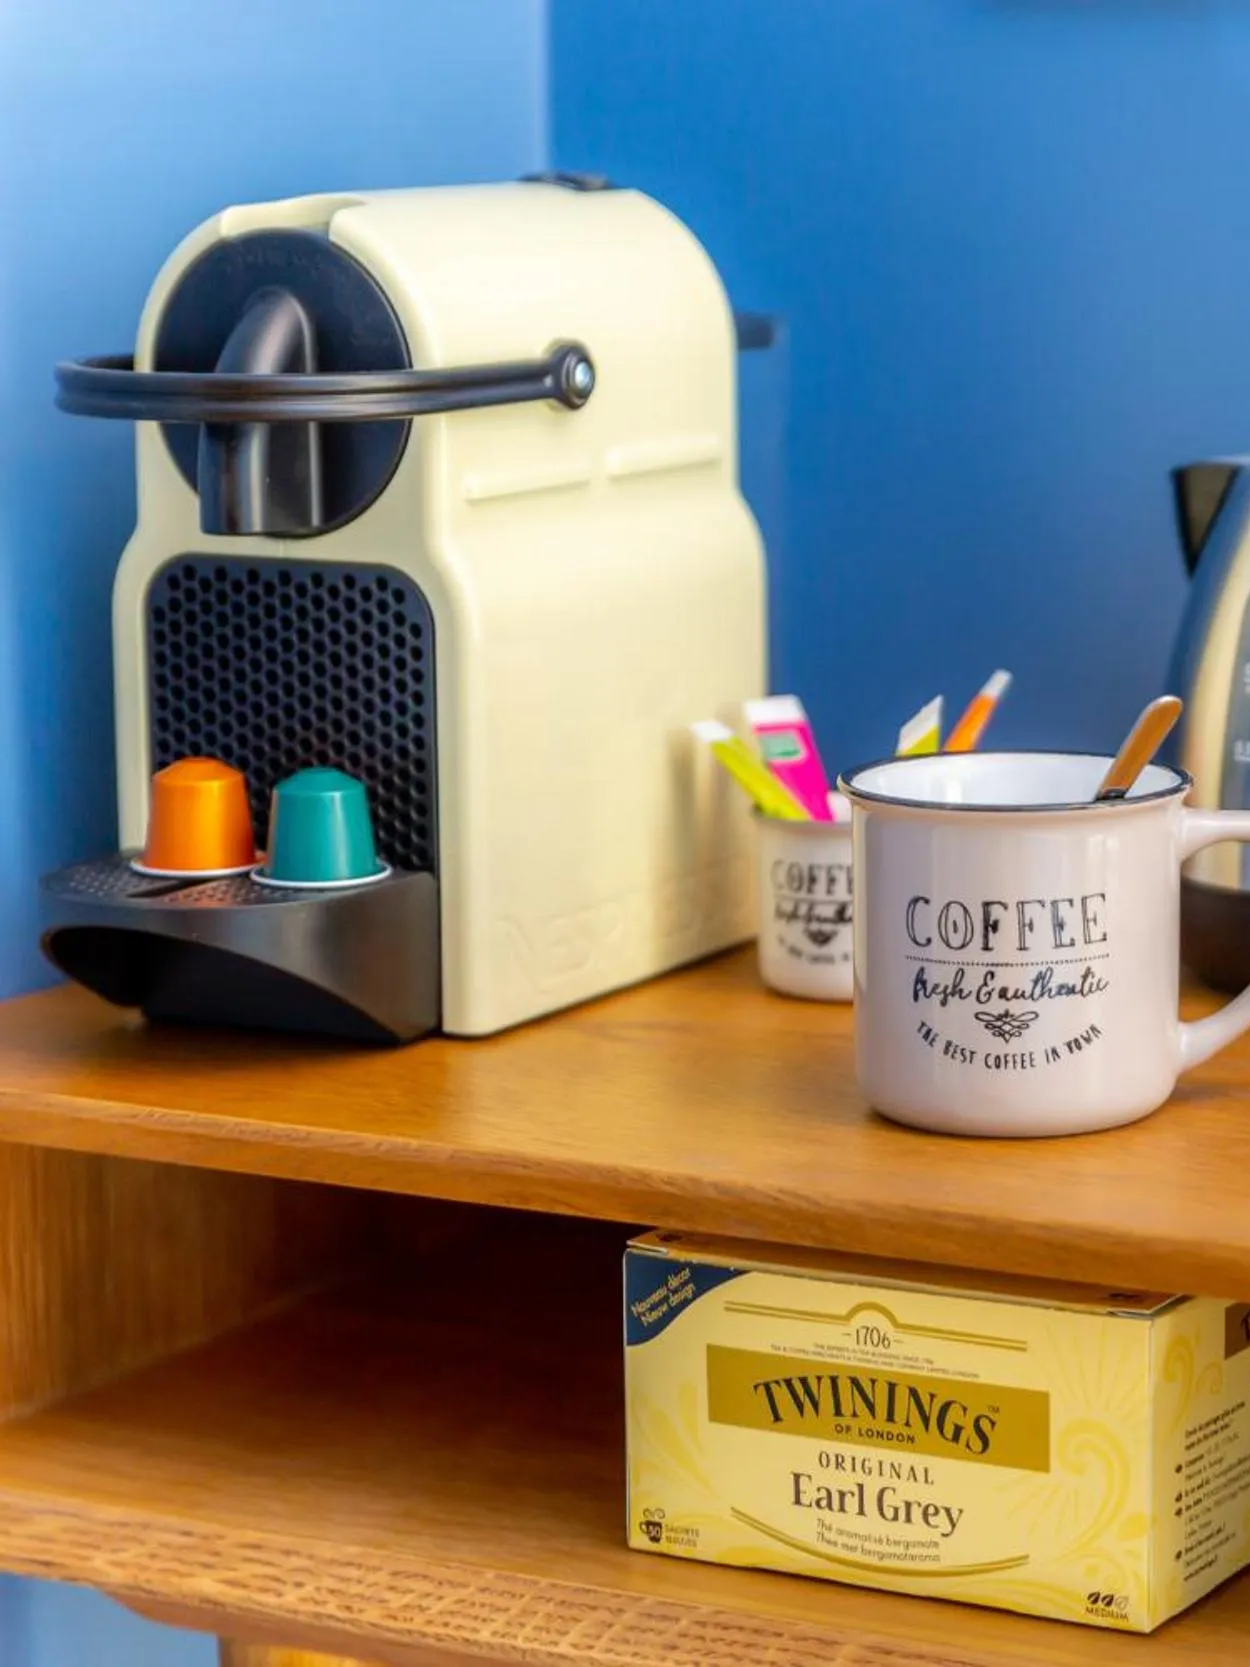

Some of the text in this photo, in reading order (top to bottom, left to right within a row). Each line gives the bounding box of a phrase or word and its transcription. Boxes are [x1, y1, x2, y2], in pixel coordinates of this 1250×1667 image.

[770, 859, 852, 895] COFF
[906, 893, 1108, 951] COFFEE
[917, 1020, 939, 1048] THE
[943, 1040, 976, 1064] BEST
[984, 1051, 1036, 1070] COFFEE
[1065, 1024, 1103, 1054] TOWN
[753, 1375, 997, 1456] TWININGS
[834, 1423, 916, 1445] OF LONDON
[818, 1450, 934, 1486] ORIGINAL
[790, 1471, 964, 1538] Earl Grey
